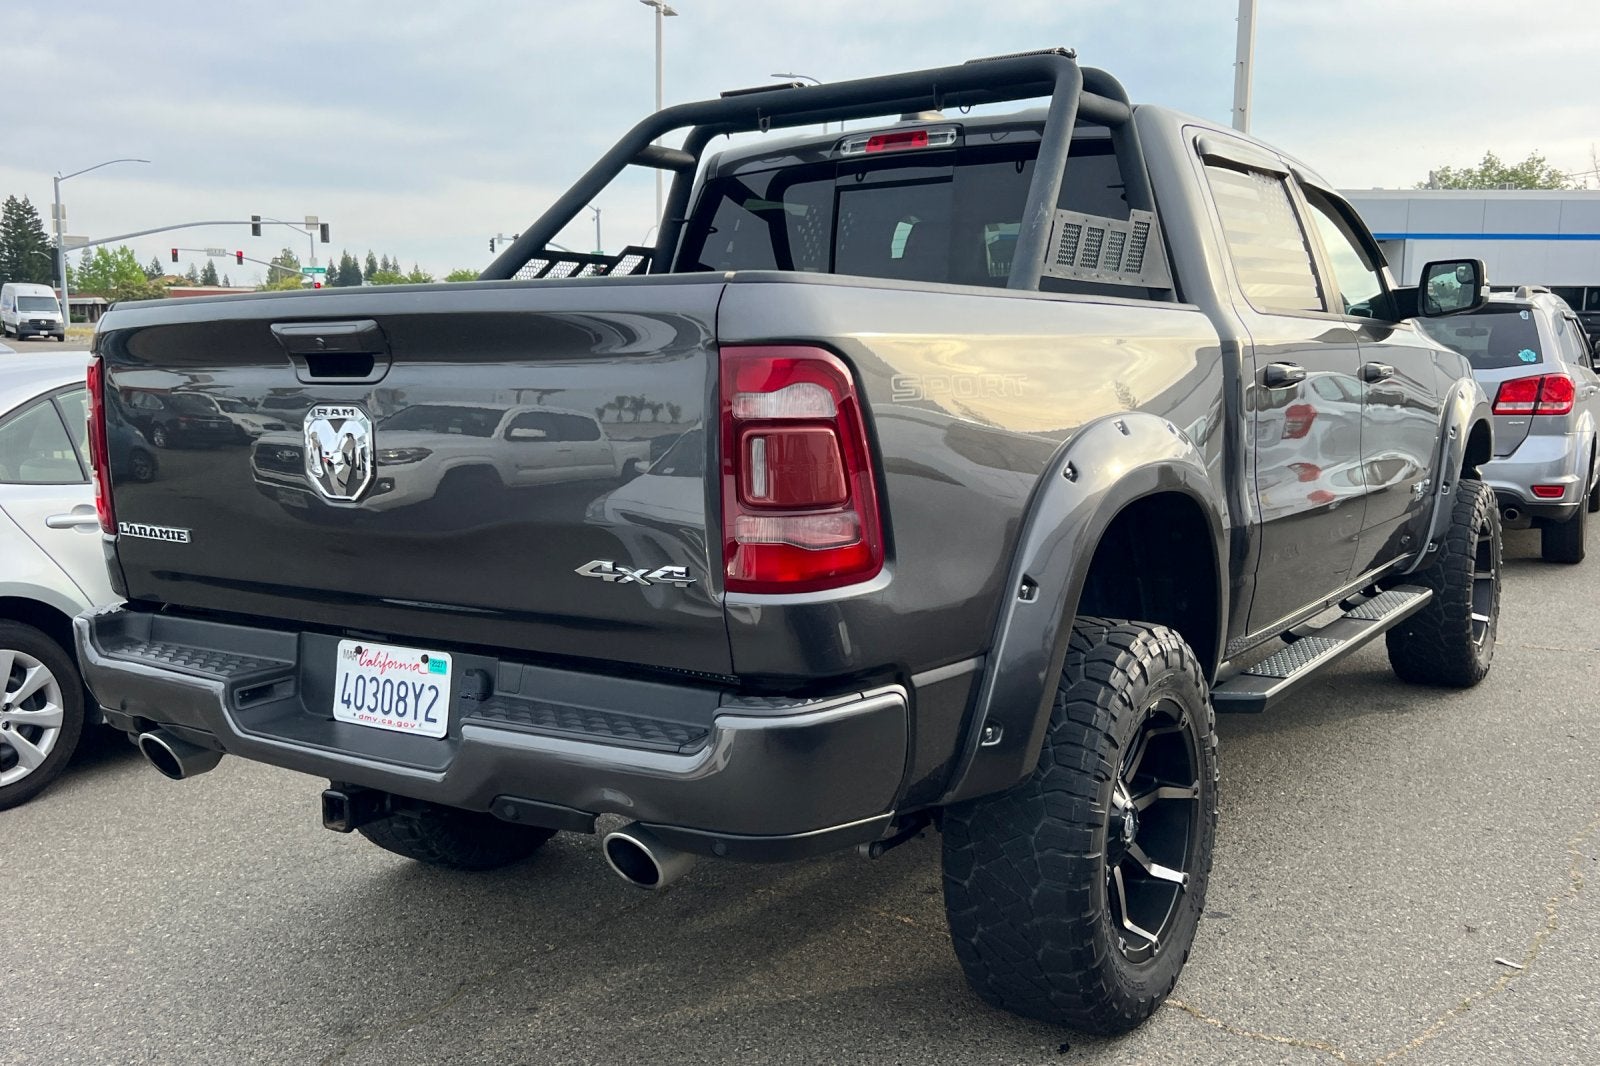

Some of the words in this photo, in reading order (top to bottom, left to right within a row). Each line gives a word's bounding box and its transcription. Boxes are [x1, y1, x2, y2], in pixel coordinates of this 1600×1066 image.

[890, 373, 1028, 402] SPORT
[316, 408, 355, 416] RAM
[119, 521, 191, 543] LARAMIE
[358, 648, 429, 675] California
[341, 672, 439, 723] 40308Y2
[358, 714, 416, 728] dmv.ca.gov
